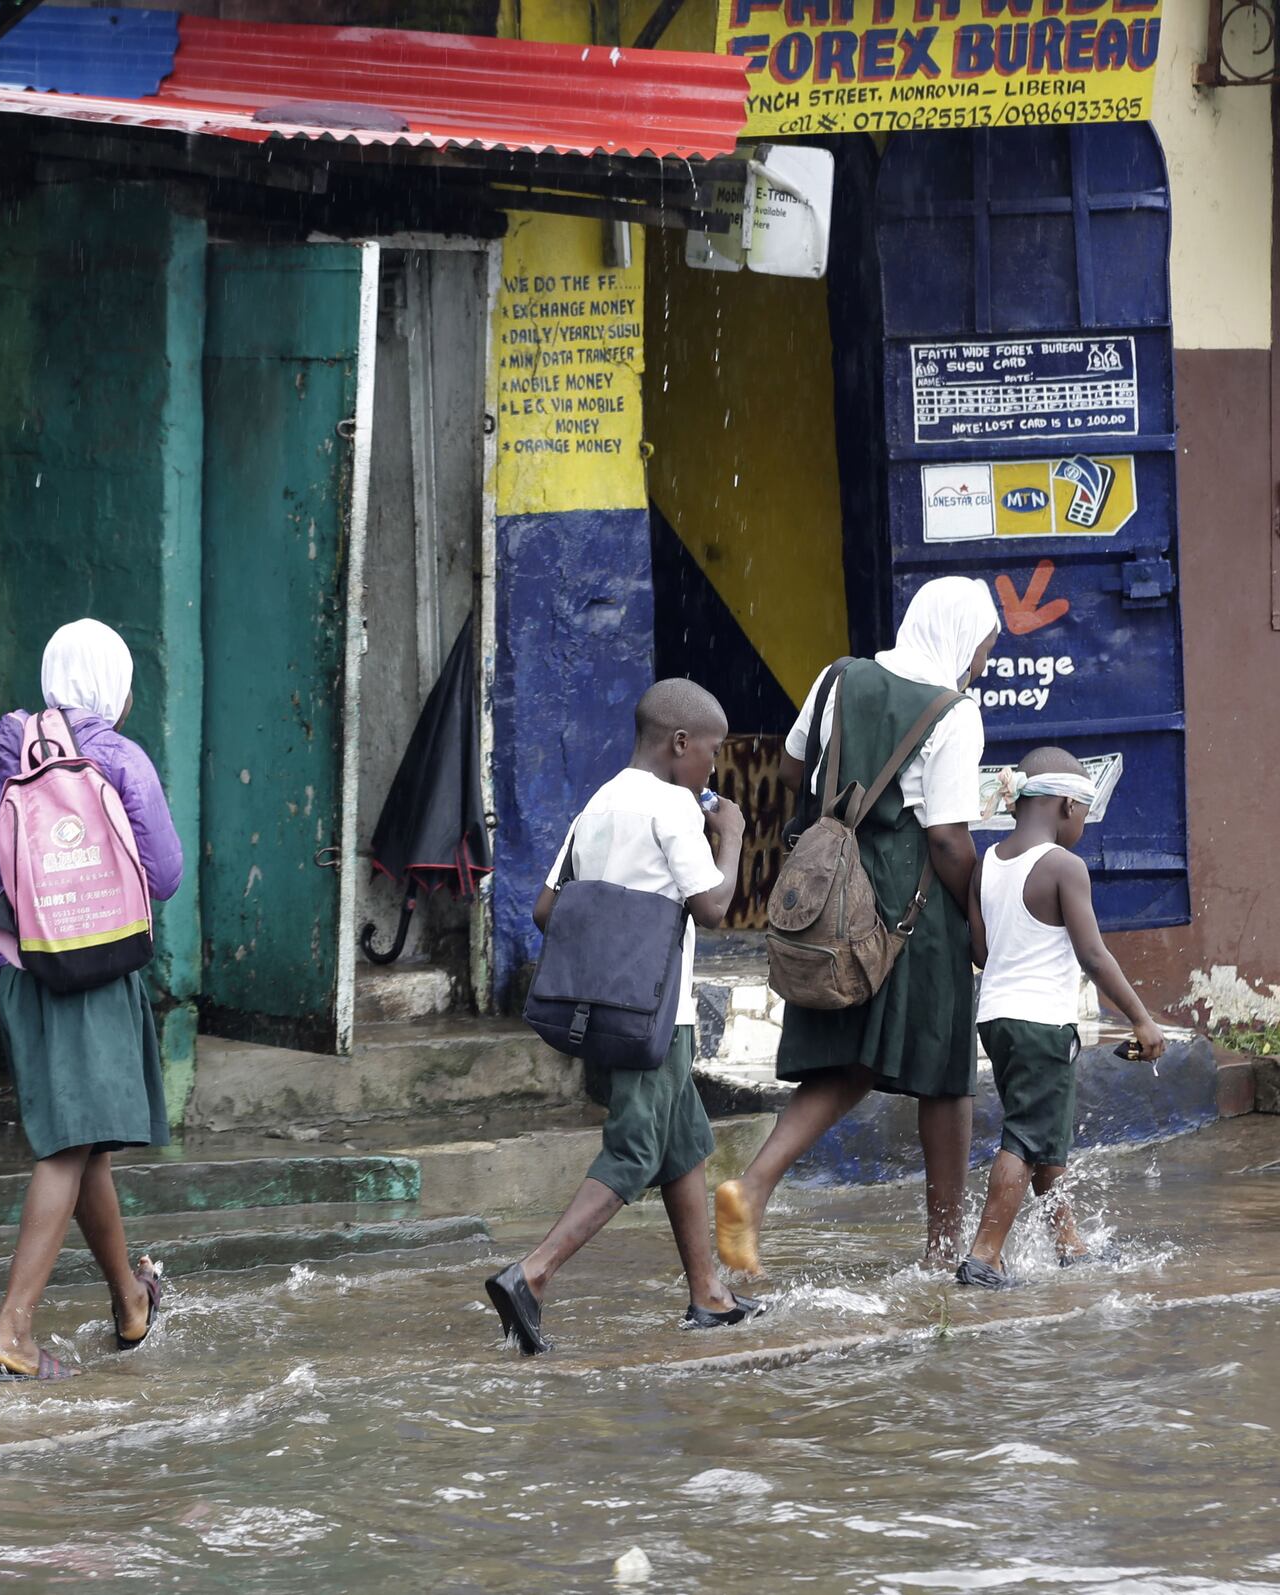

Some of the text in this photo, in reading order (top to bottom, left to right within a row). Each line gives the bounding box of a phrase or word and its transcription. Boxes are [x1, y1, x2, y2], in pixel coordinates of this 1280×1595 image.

[727, 17, 1161, 84] FOREX BUREAU
[746, 91, 799, 114] YNCH
[889, 82, 979, 103] MONROVIA
[1005, 80, 1086, 97] LIBERIA
[717, 187, 745, 203] Mobil
[754, 206, 787, 217] Available
[753, 220, 770, 230] Here
[504, 277, 529, 293] WE
[534, 276, 556, 293] DO
[561, 275, 590, 291] THE
[513, 299, 635, 319] EXCHANGE MONEY
[608, 323, 640, 340] SUSU
[918, 342, 1084, 361] FAITH WIDE FOREX BUREAU
[946, 357, 1026, 373] SUSU CARD
[510, 373, 614, 392] MOBILE MONEY
[551, 397, 573, 413] VIA
[578, 396, 624, 413] MOBILE
[556, 419, 600, 434] MONEY
[985, 419, 1014, 432] LOST
[1019, 417, 1047, 429] CARD
[1051, 417, 1061, 428] IS
[1067, 416, 1082, 428] LD
[514, 439, 622, 454] ORANGE MONEY
[928, 494, 972, 508] LONESTAR
[1007, 491, 1046, 508] MTN
[981, 656, 1075, 686] range
[965, 687, 1049, 711] Money
